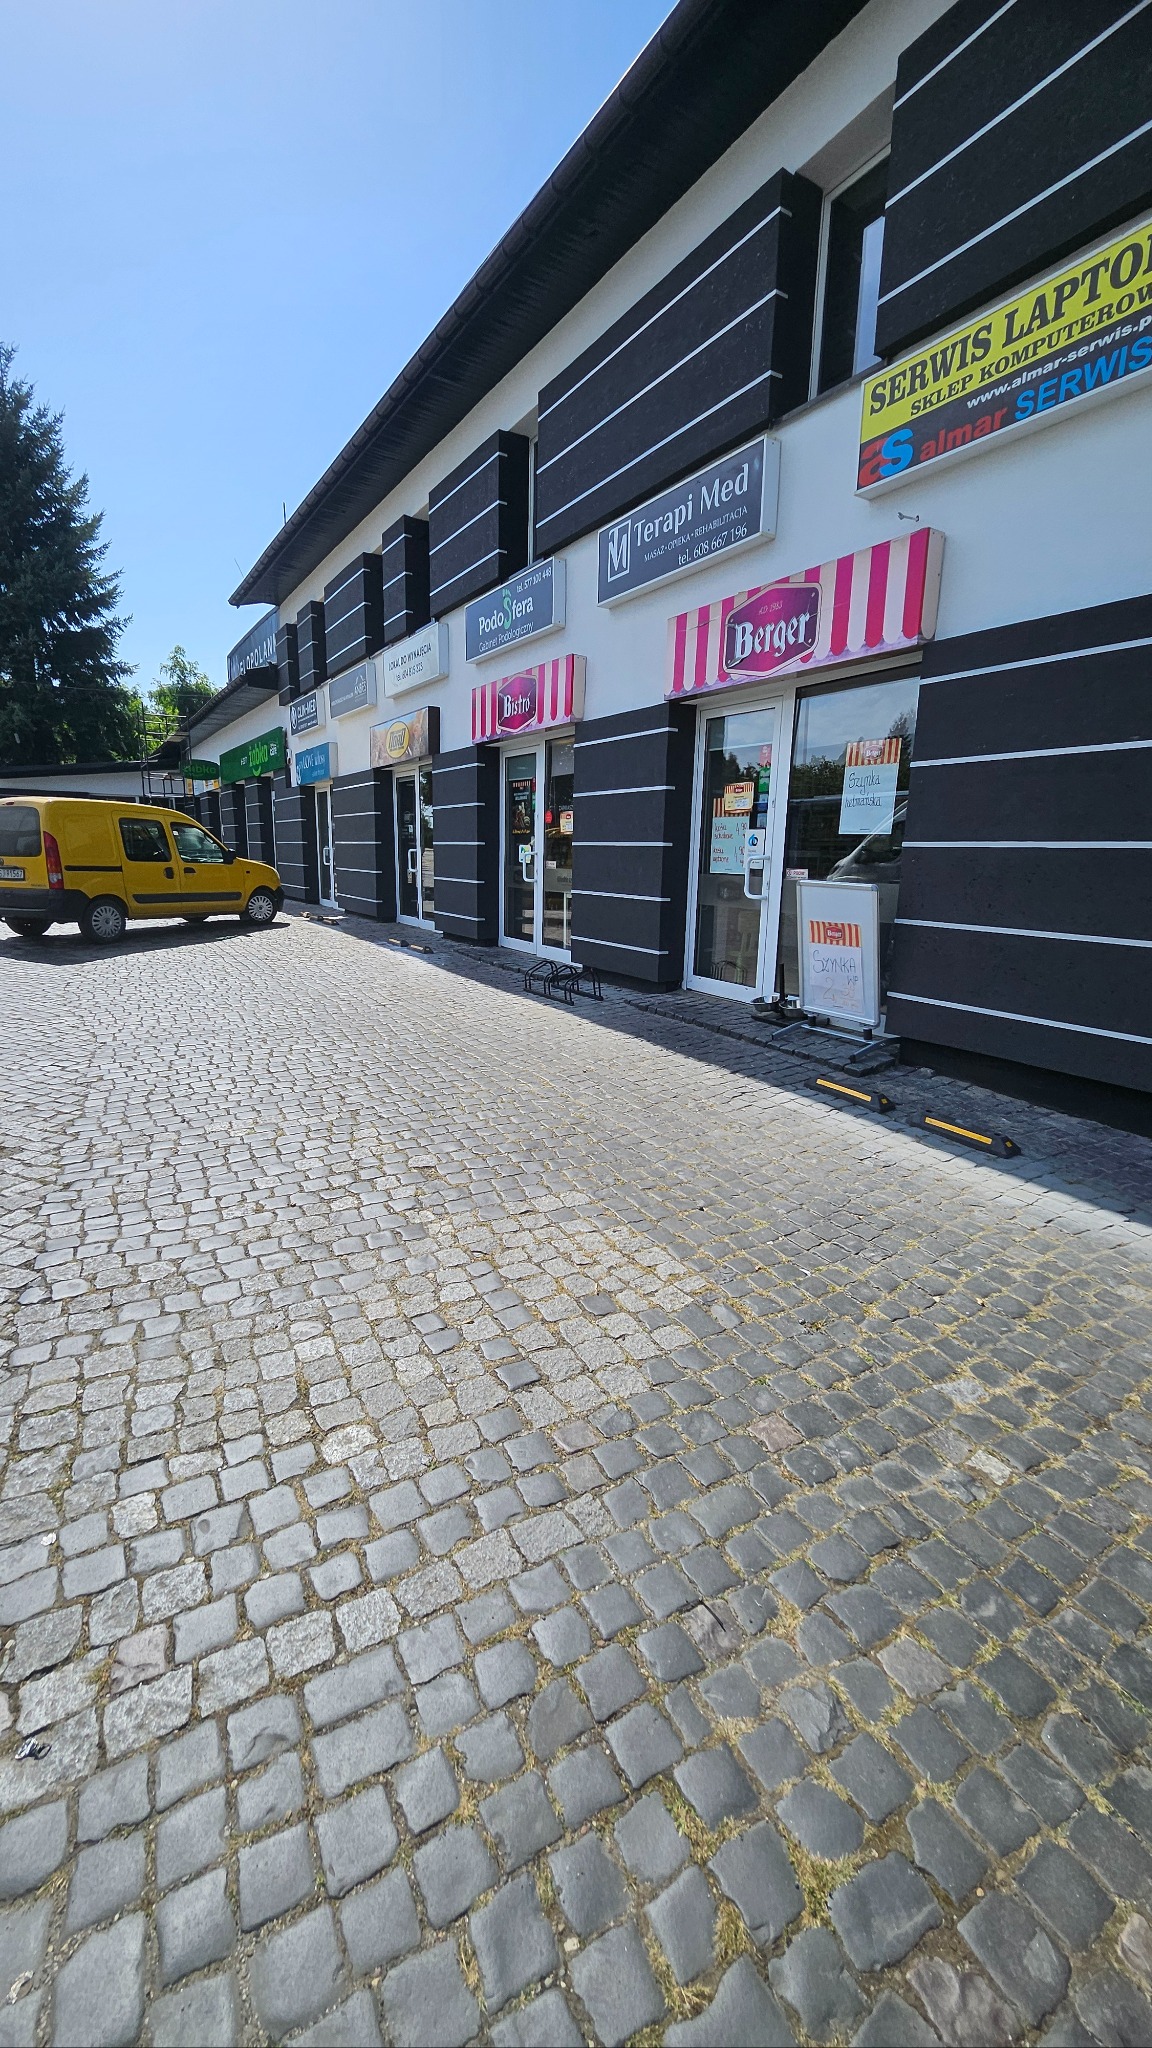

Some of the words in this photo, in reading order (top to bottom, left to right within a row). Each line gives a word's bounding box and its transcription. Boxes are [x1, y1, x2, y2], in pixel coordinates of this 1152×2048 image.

[870, 322, 993, 416] SERWIS
[911, 374, 973, 416] SKLEP
[920, 407, 1007, 461] almar
[1014, 336, 1152, 420] SERWIS
[634, 494, 694, 547] Terapi
[700, 463, 749, 515] Med
[678, 548, 692, 566] tel.
[694, 540, 709, 559] 608
[711, 531, 728, 551] 667
[730, 522, 748, 542] 196
[479, 595, 534, 636] PodoSfera
[734, 610, 810, 660] Berger
[504, 694, 530, 718] Bistro
